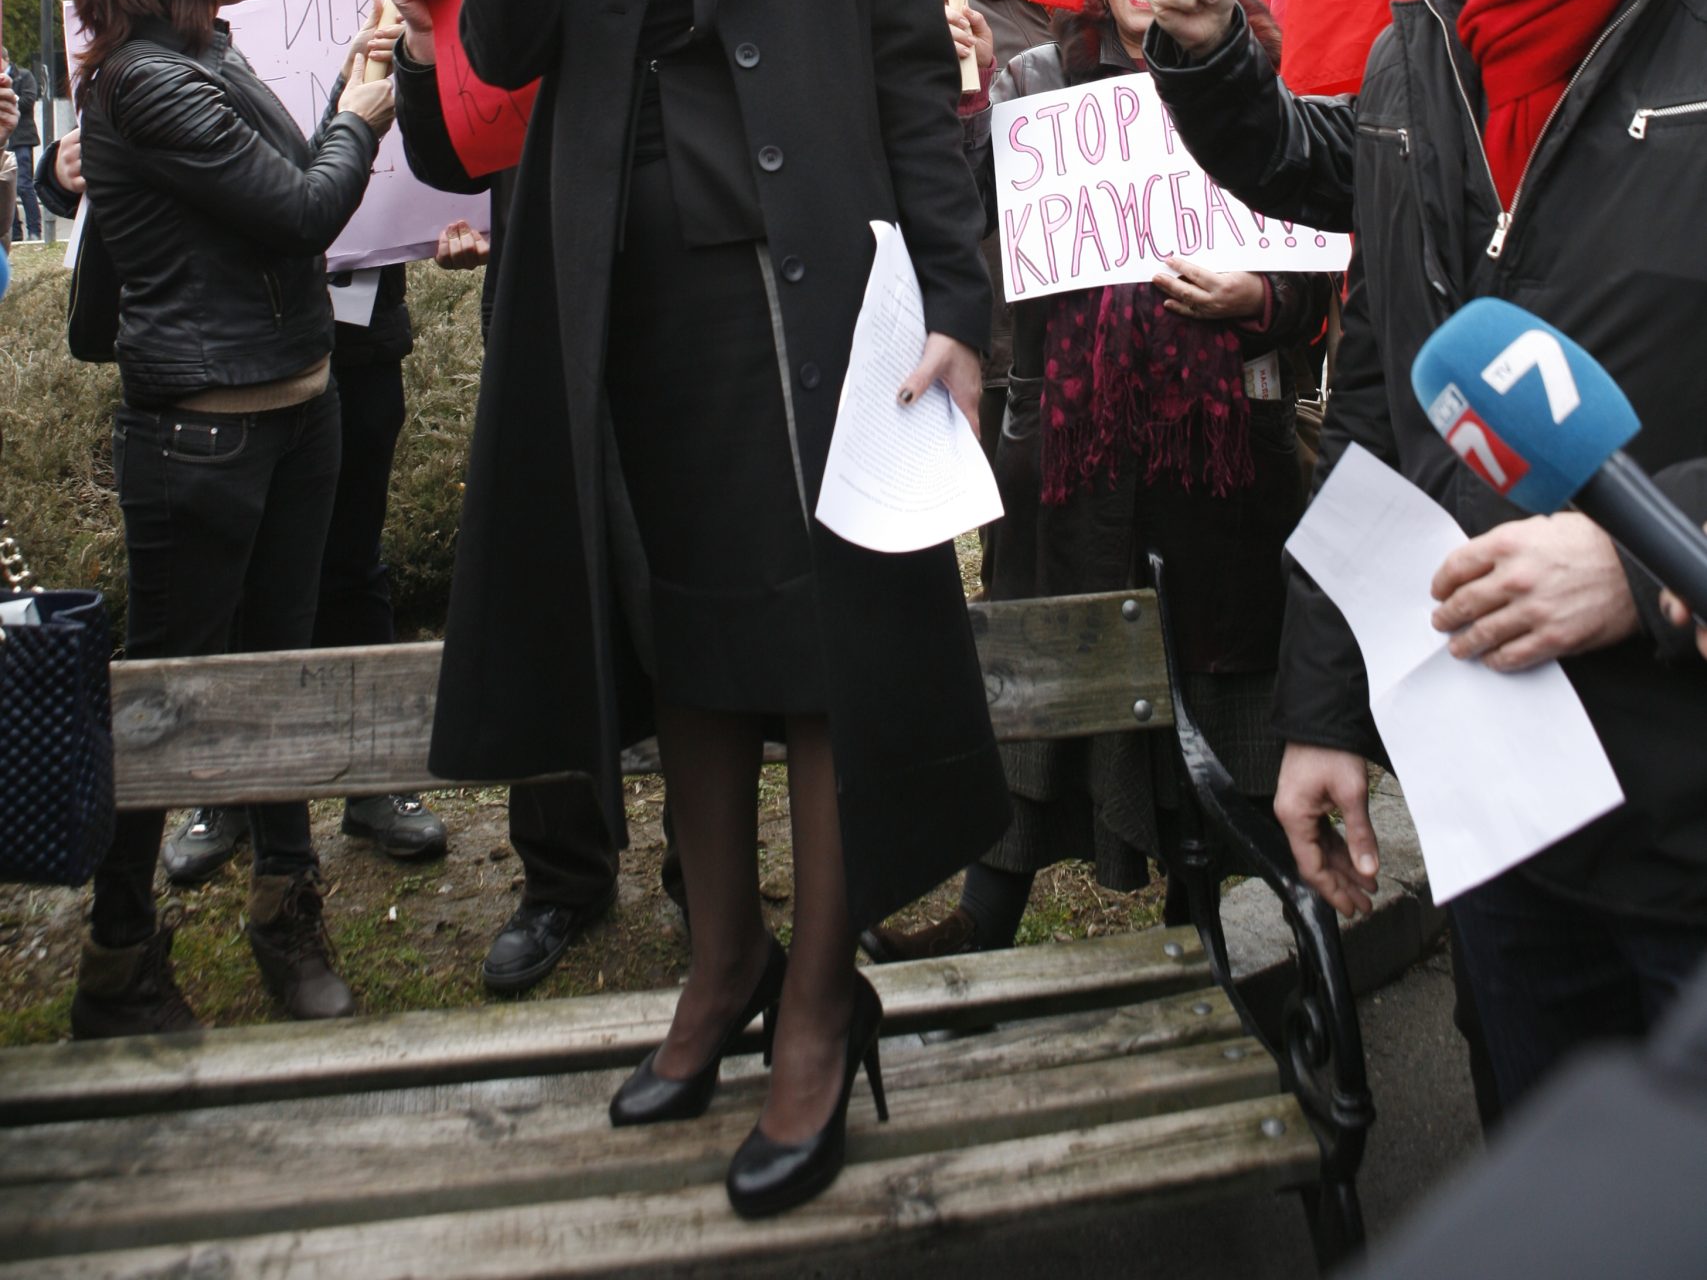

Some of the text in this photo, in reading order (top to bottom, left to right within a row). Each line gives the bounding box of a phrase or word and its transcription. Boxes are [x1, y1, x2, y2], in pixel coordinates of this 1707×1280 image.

[1008, 86, 1140, 191] STOP
[1004, 170, 1327, 295] КРАЖБА
[1480, 329, 1582, 425] 7
[1450, 421, 1509, 488] 7
